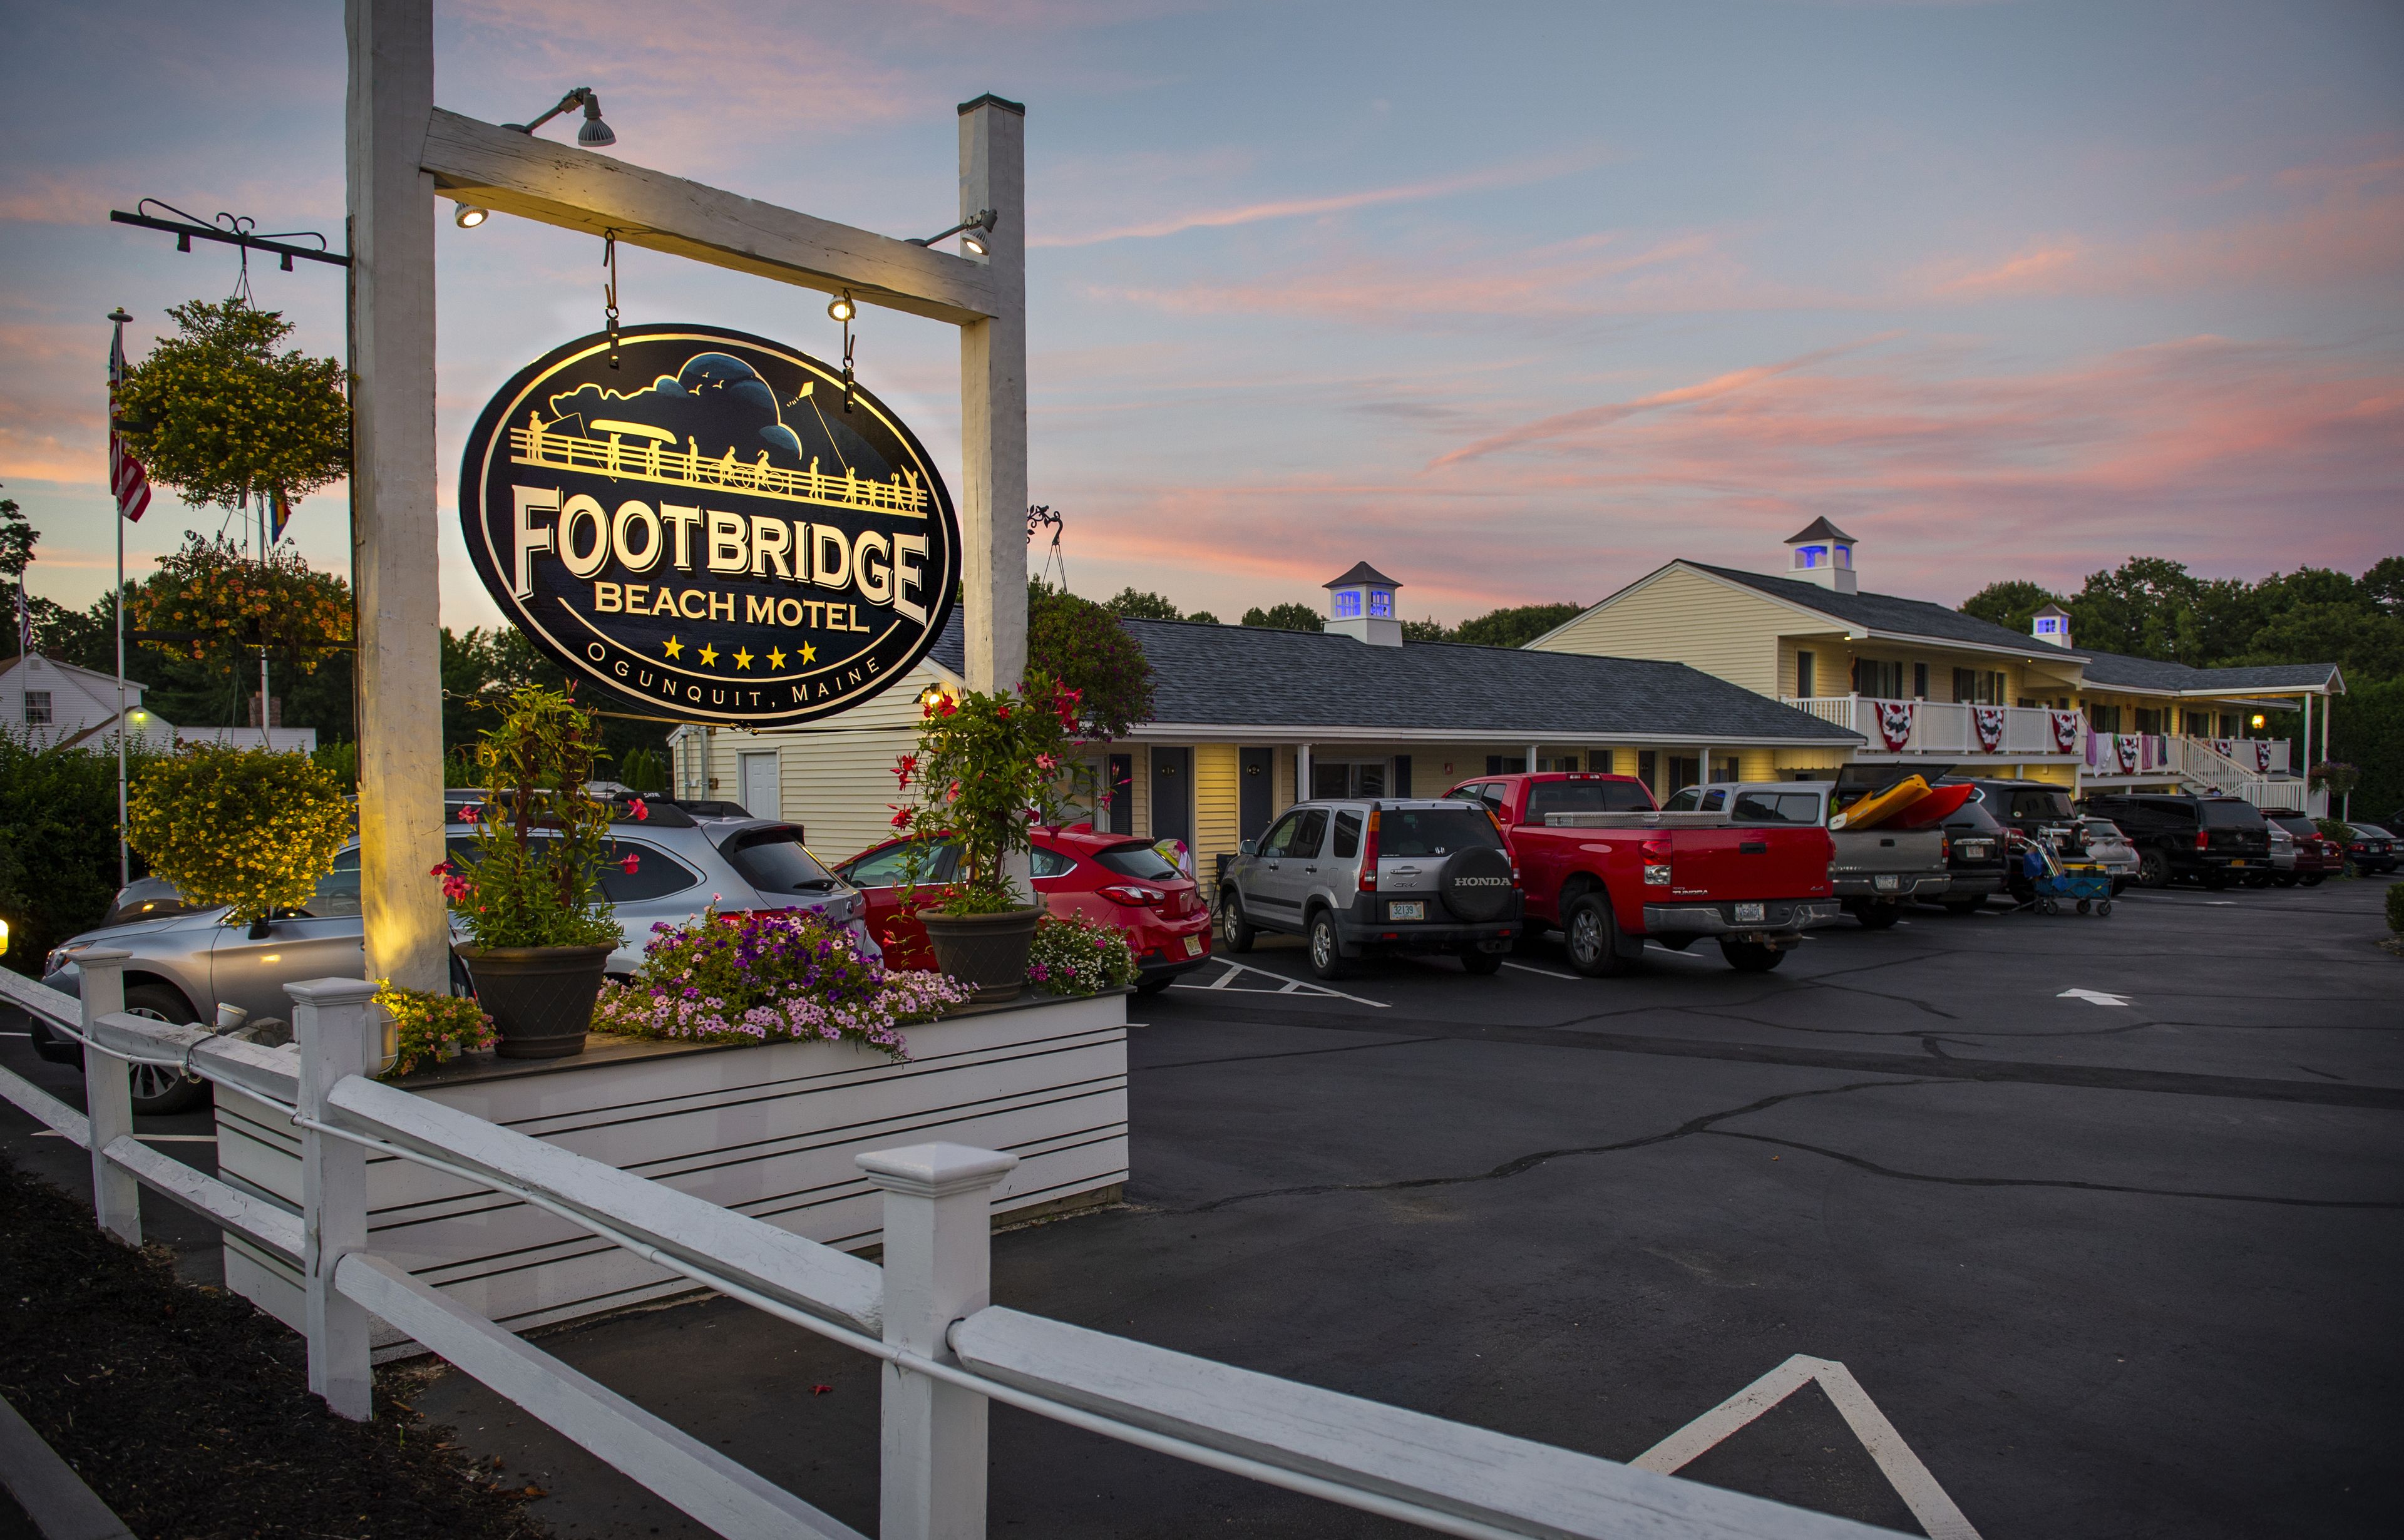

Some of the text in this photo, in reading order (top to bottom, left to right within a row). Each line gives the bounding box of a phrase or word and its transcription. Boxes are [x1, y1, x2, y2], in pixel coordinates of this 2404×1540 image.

[511, 484, 930, 628] FOOTBRIDGE
[594, 581, 870, 634] BEACH MOTEL
[587, 642, 880, 708] OGUNQUIT, MAINE
[1454, 877, 1512, 886] HONDA
